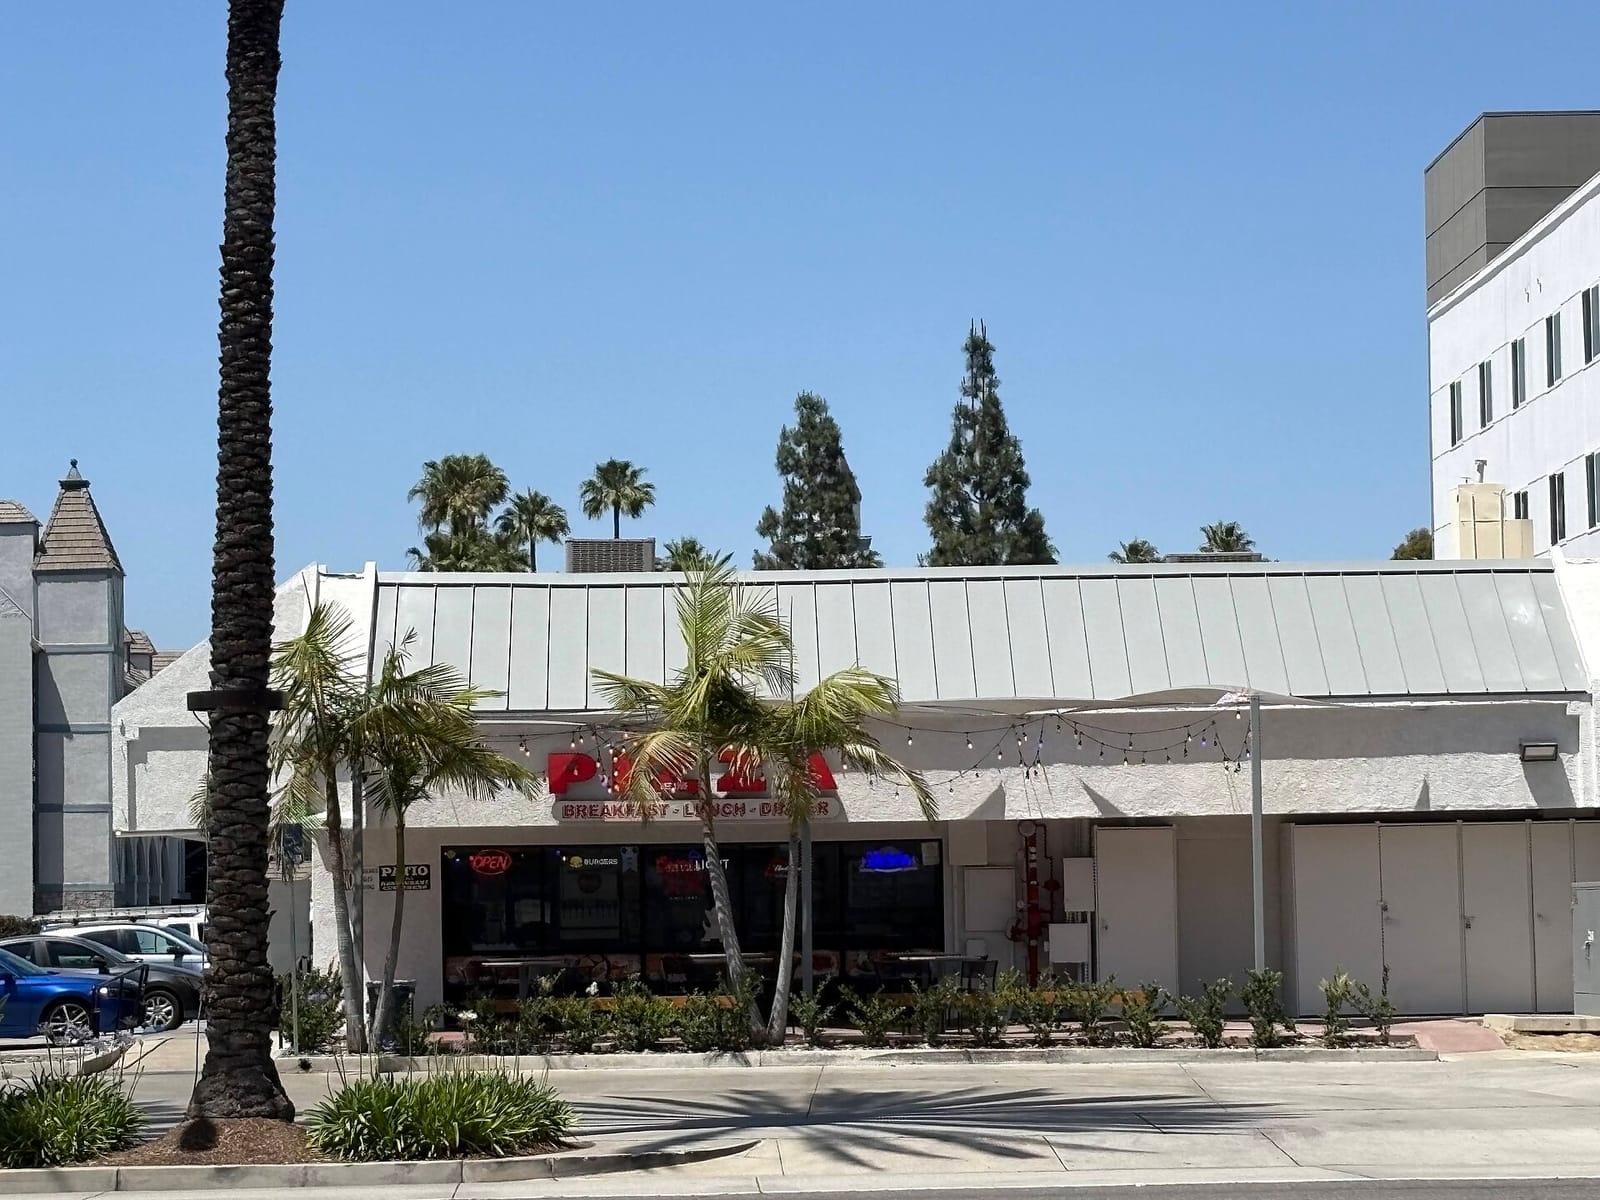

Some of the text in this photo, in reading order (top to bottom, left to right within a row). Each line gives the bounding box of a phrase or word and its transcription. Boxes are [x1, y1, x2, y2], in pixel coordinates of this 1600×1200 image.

[473, 855, 508, 871] OPEN
[583, 858, 619, 866] BURGERS
[695, 858, 730, 870] LIT
